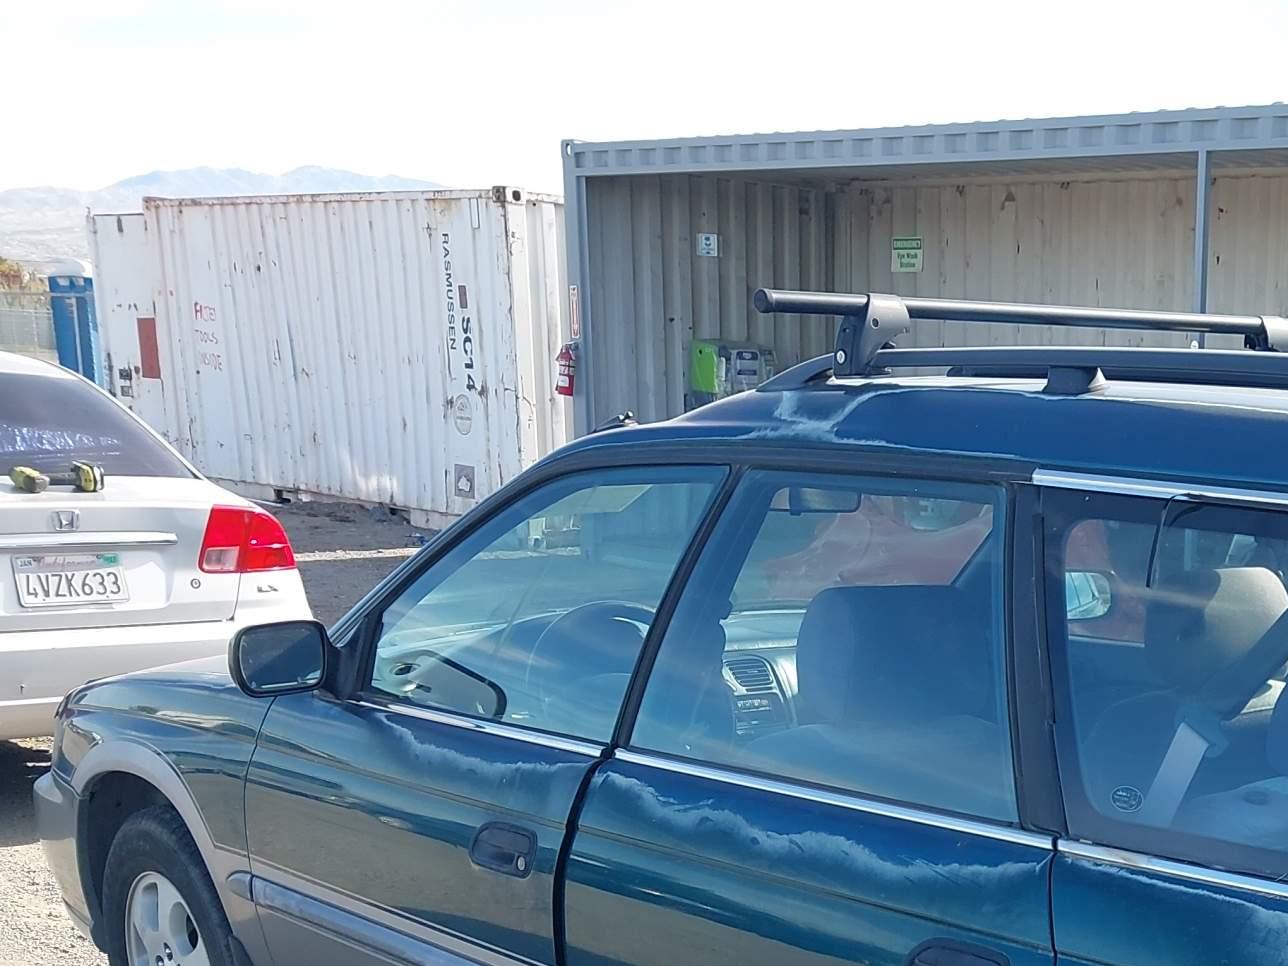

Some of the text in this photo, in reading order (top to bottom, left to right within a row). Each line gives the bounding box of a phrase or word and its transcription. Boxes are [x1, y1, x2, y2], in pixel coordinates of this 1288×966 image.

[441, 232, 457, 350] RASMUSSEN
[461, 315, 478, 392] SC14
[26, 571, 121, 598] 4VZK633
